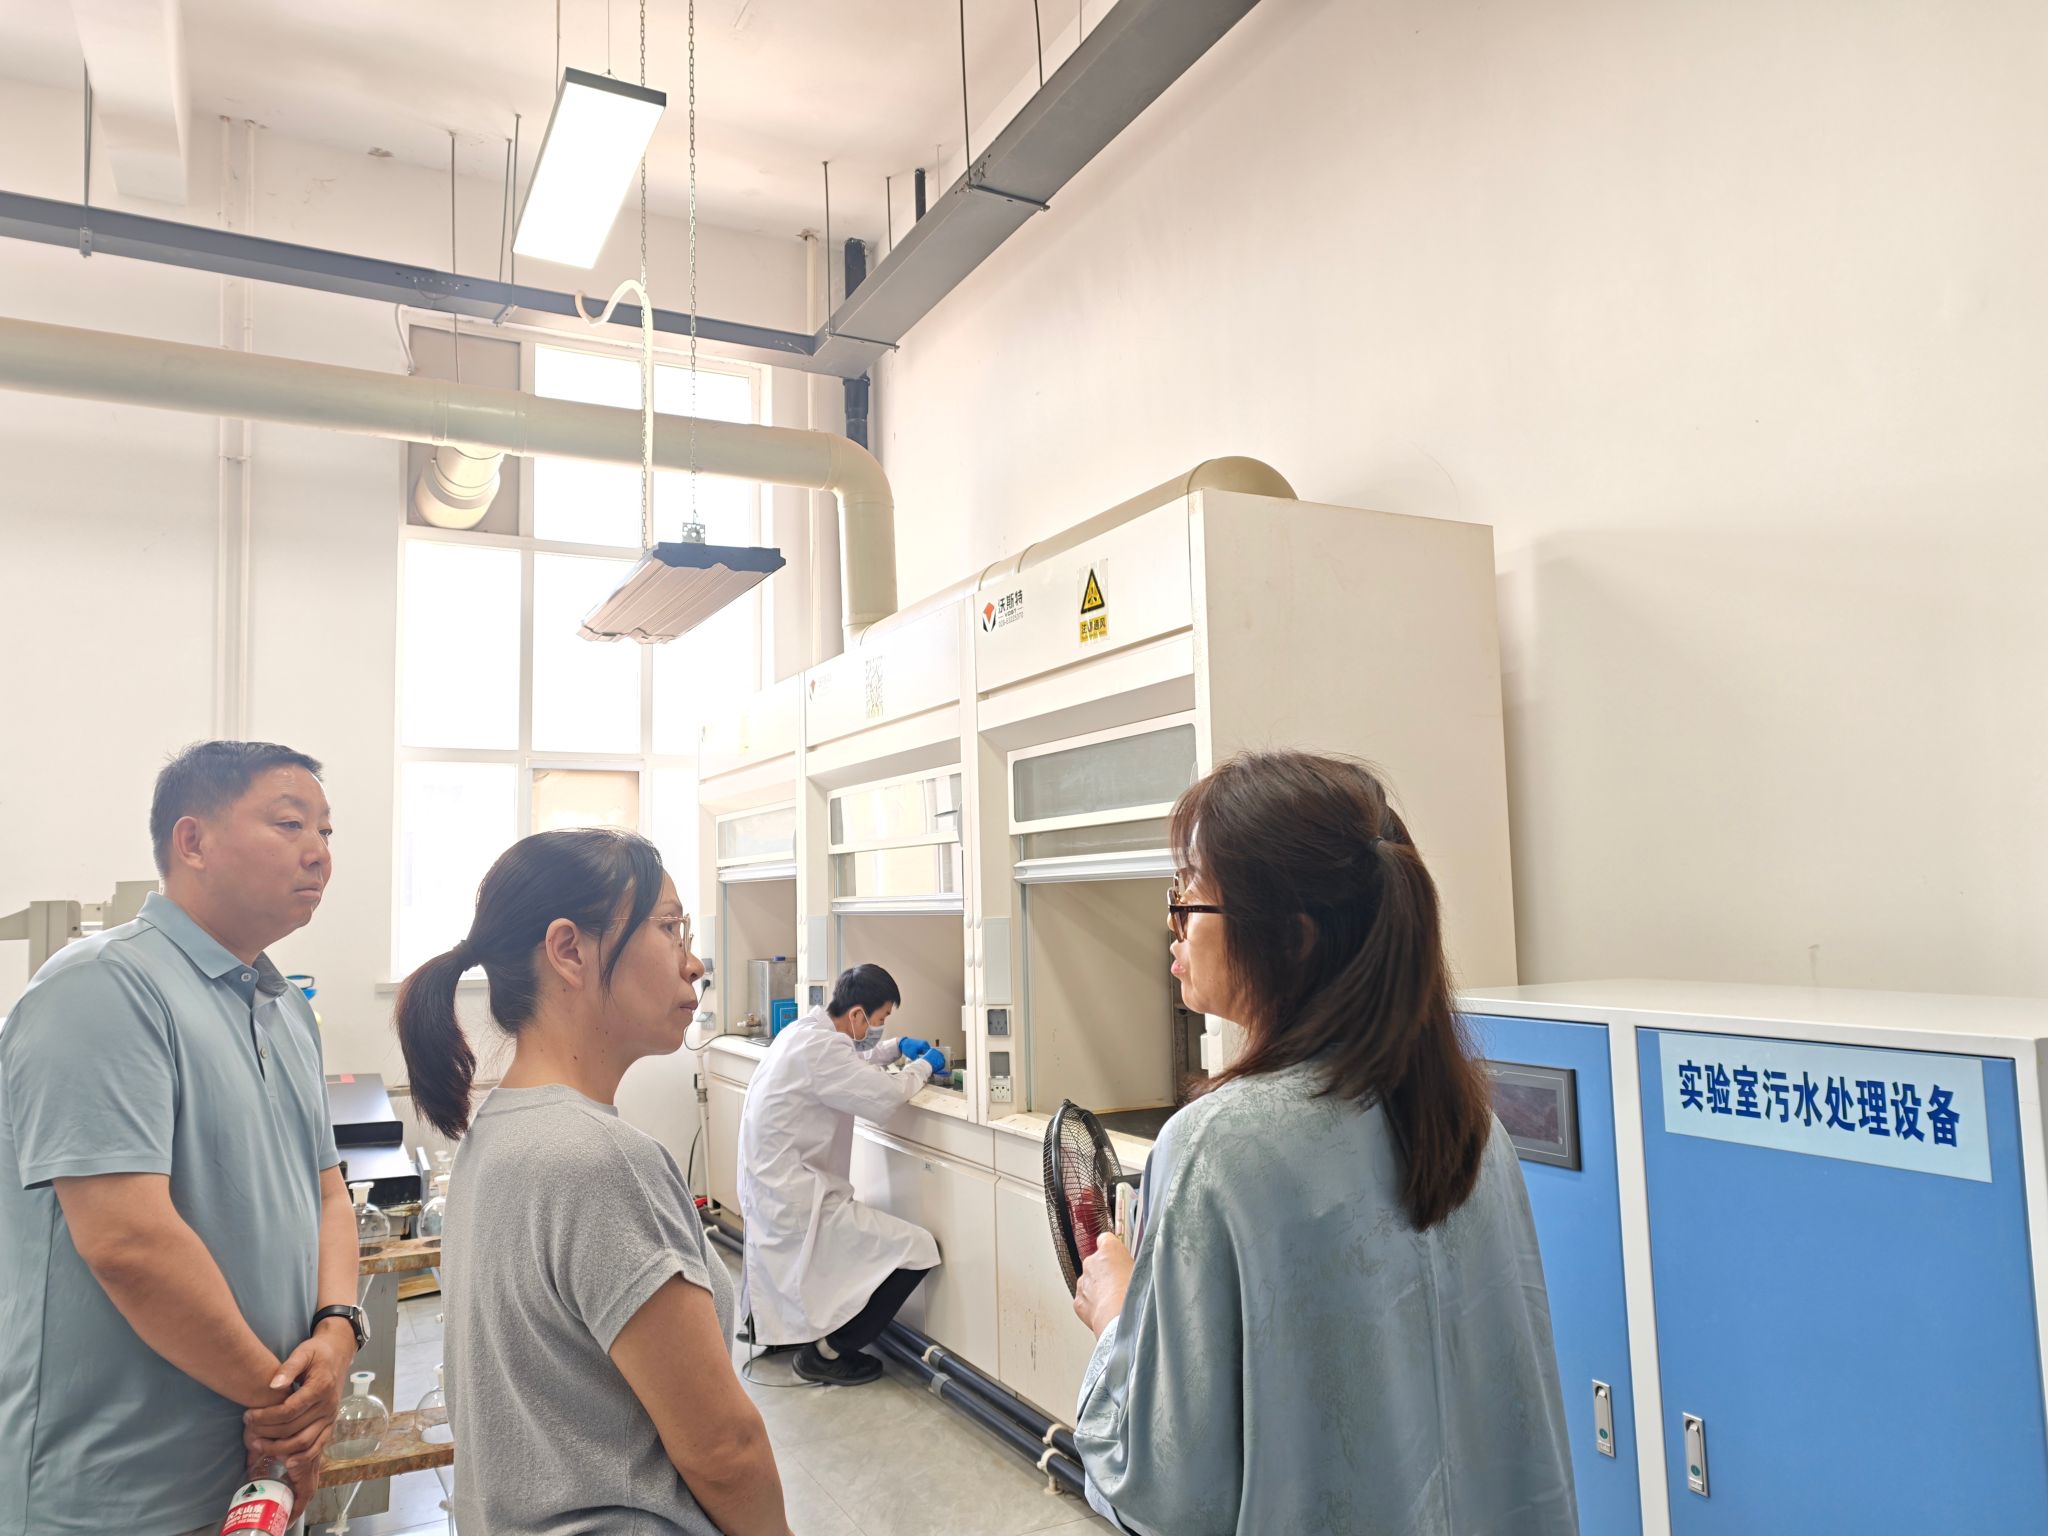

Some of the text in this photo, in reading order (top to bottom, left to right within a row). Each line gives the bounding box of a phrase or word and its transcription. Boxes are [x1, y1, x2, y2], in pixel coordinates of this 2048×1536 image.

[998, 589, 1023, 614] 沃斯特
[1678, 1059, 1961, 1147] 实验室污水处理设备
